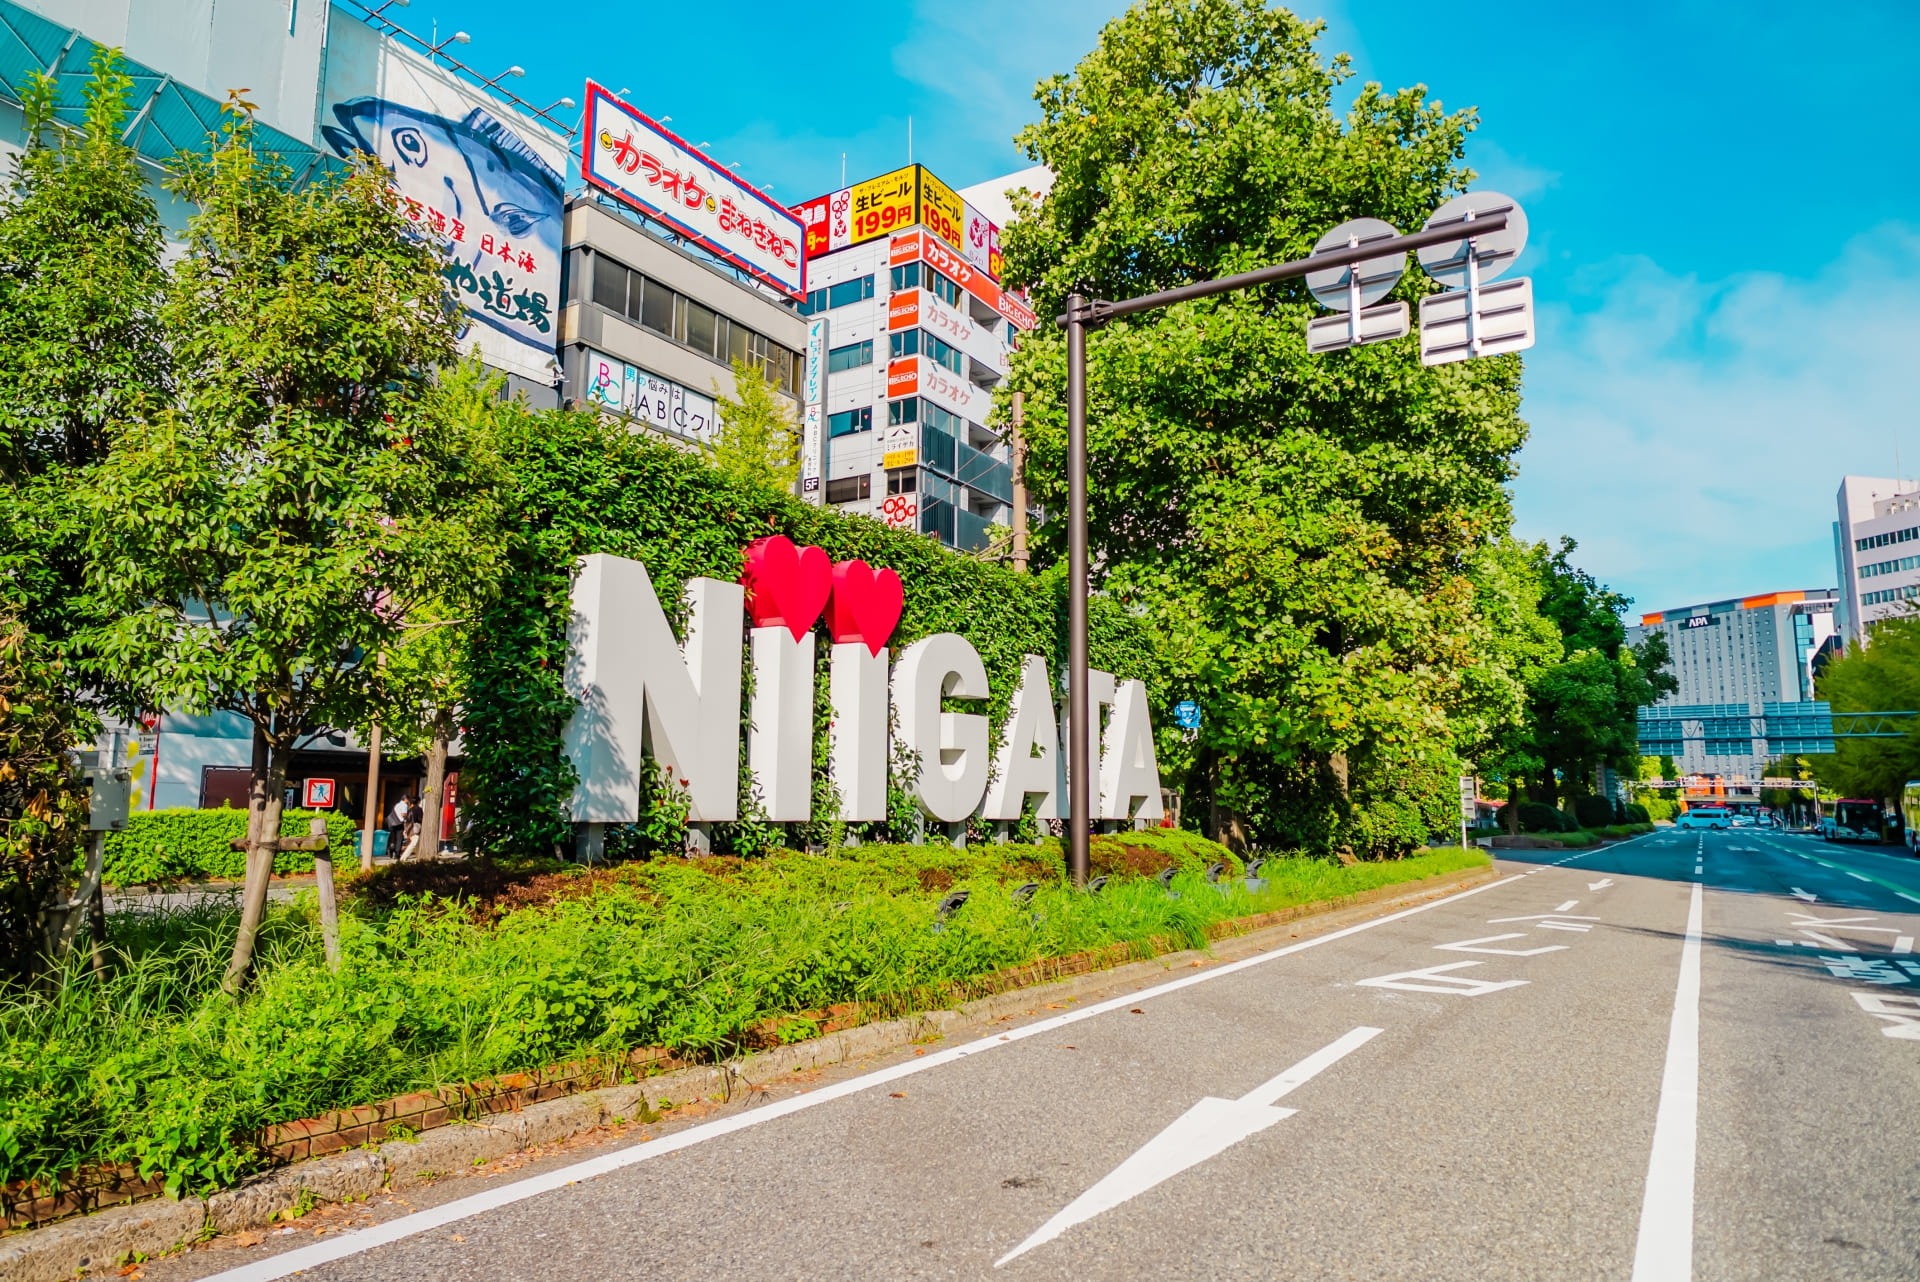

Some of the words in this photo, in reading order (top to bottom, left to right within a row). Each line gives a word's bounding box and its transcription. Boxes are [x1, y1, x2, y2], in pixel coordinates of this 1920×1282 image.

[612, 131, 707, 209] カラオケ
[718, 196, 799, 270] まねきねこ
[856, 181, 912, 213] 生ビール
[923, 183, 961, 222] 生ビール
[855, 205, 912, 237] 199円
[923, 204, 961, 249] 199円
[480, 233, 537, 274] 日本海
[927, 243, 972, 283] カラオケ
[927, 304, 971, 341] カラオケ
[625, 367, 681, 400] 男の悩みは
[926, 371, 971, 407] カラオケ
[805, 479, 818, 491] 5F
